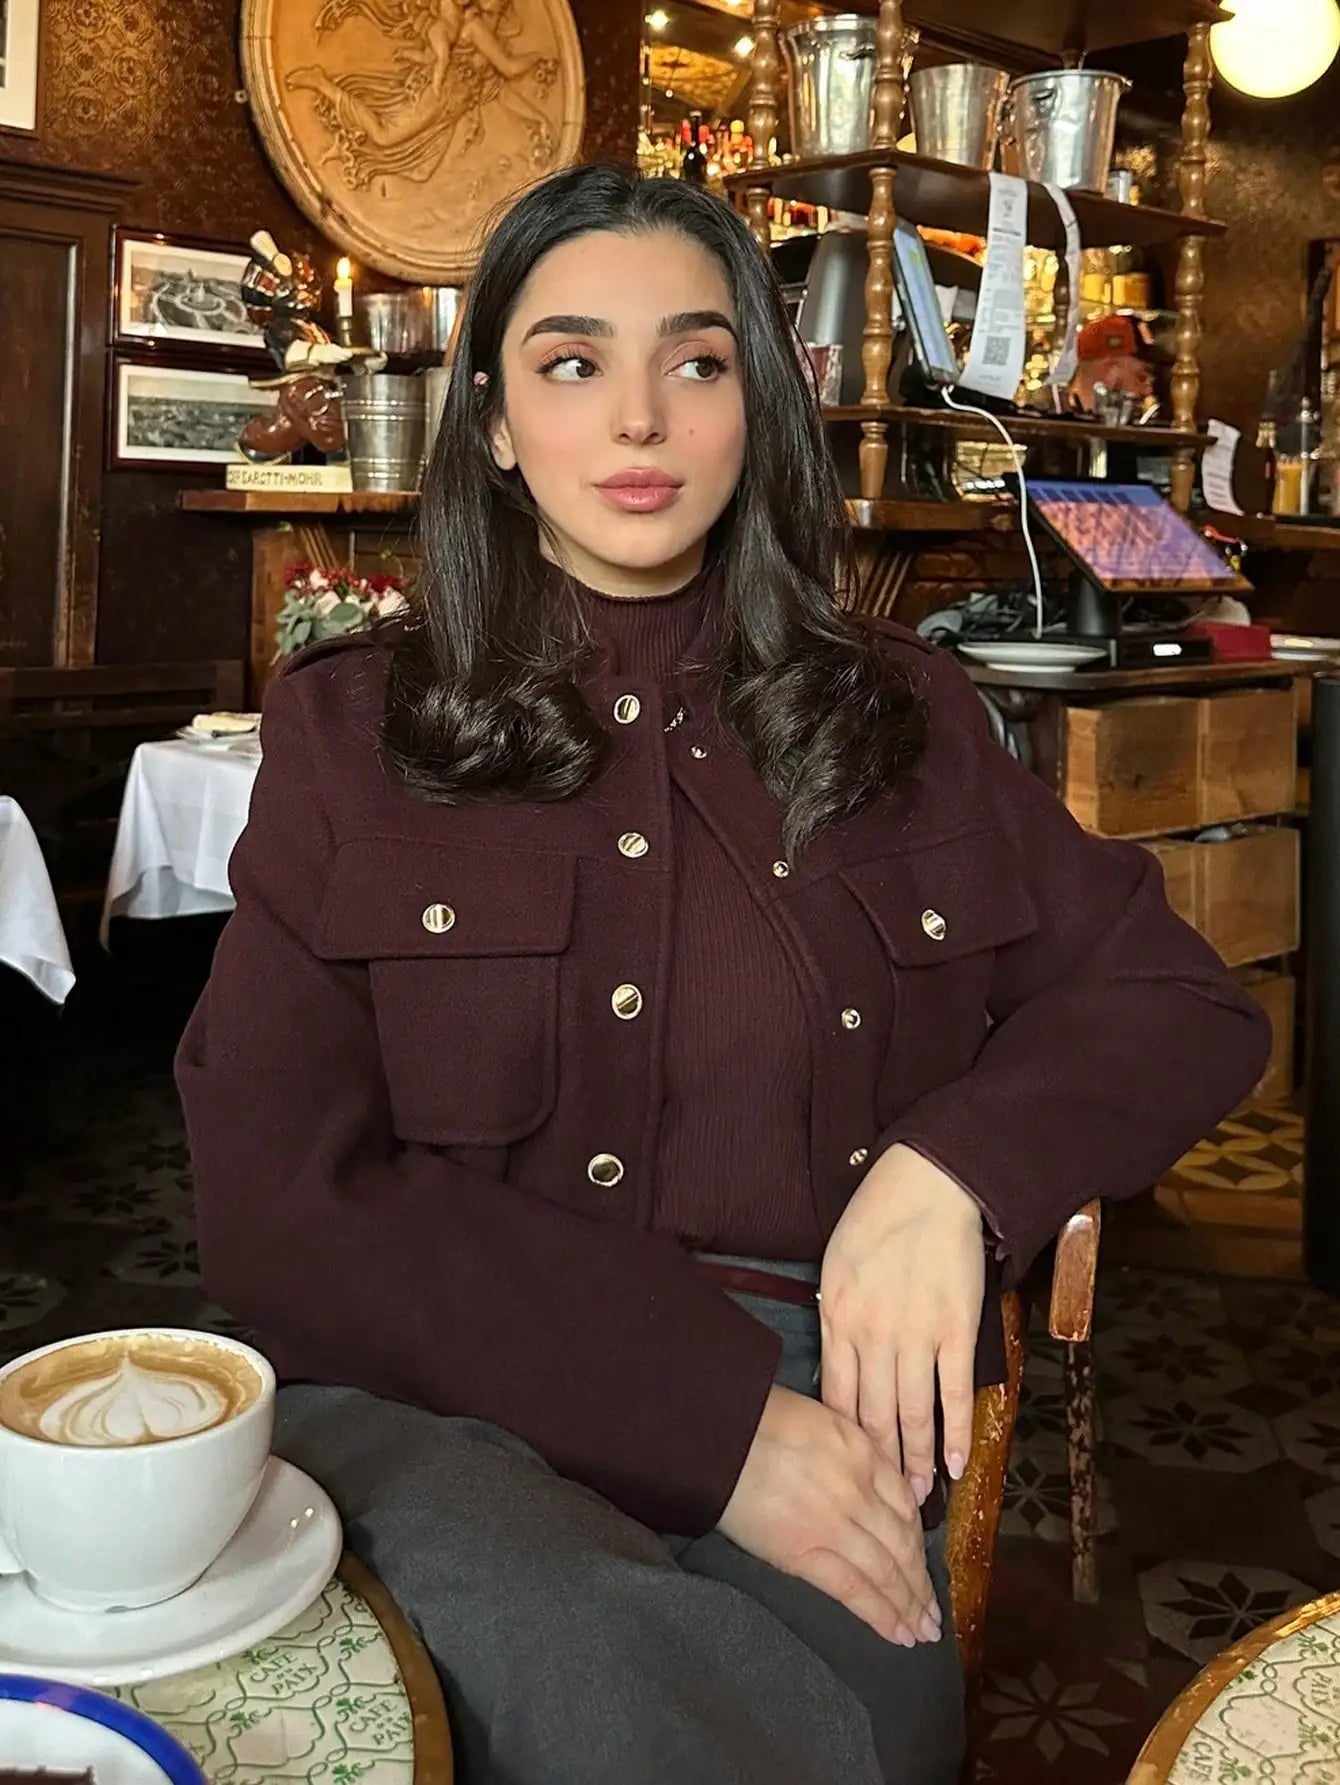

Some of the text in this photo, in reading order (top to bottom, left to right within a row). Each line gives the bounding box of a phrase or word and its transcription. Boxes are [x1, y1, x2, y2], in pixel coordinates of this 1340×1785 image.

[250, 1651, 298, 1683] CAFE
[271, 1662, 318, 1695] PAIX
[349, 1699, 398, 1733] CAFE
